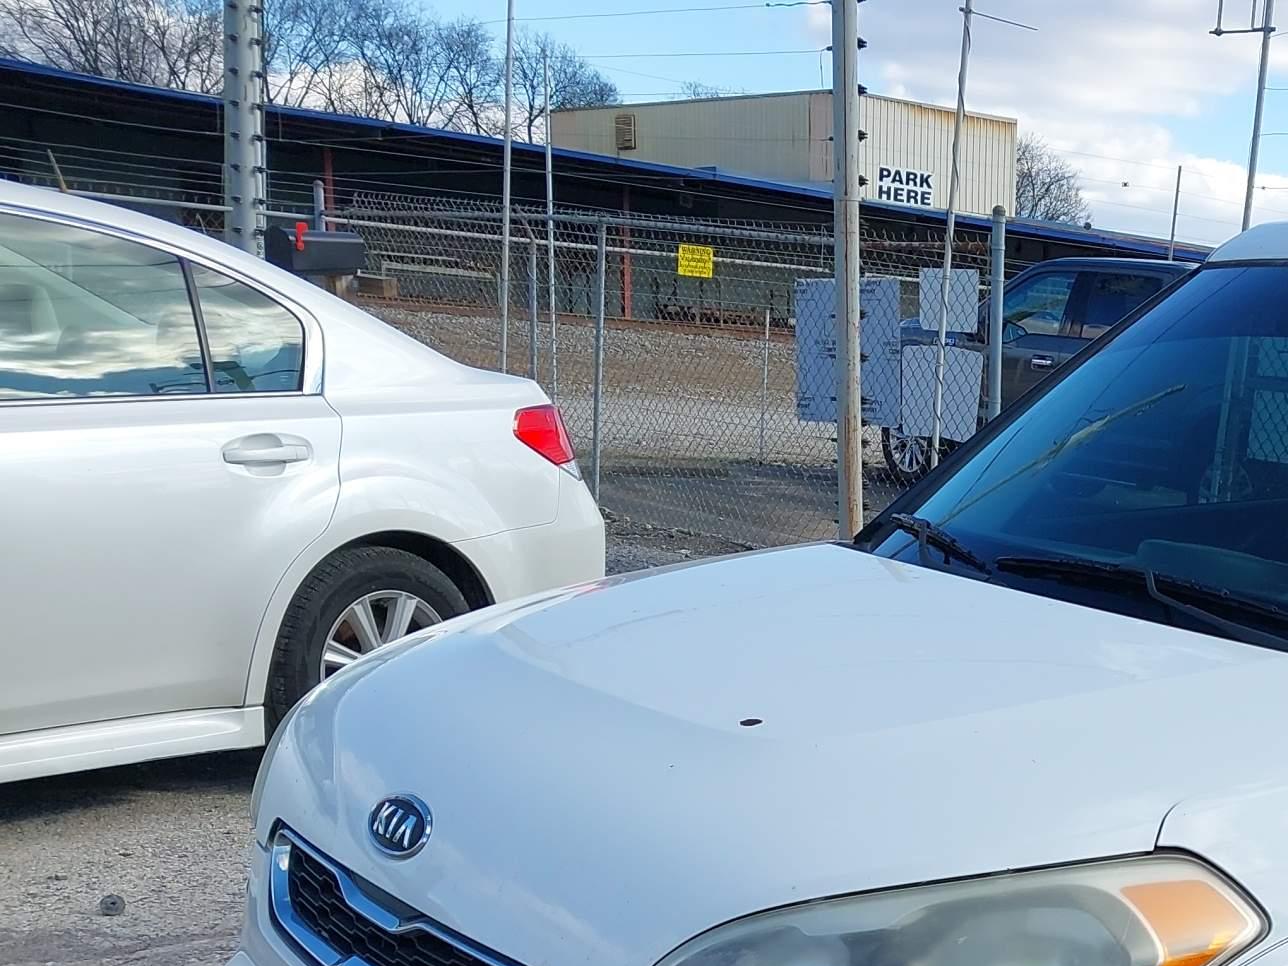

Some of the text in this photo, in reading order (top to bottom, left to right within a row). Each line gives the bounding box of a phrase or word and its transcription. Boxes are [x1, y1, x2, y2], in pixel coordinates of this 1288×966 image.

[879, 167, 933, 189] PARK
[878, 185, 931, 206] HERE
[373, 802, 416, 848] KIA
